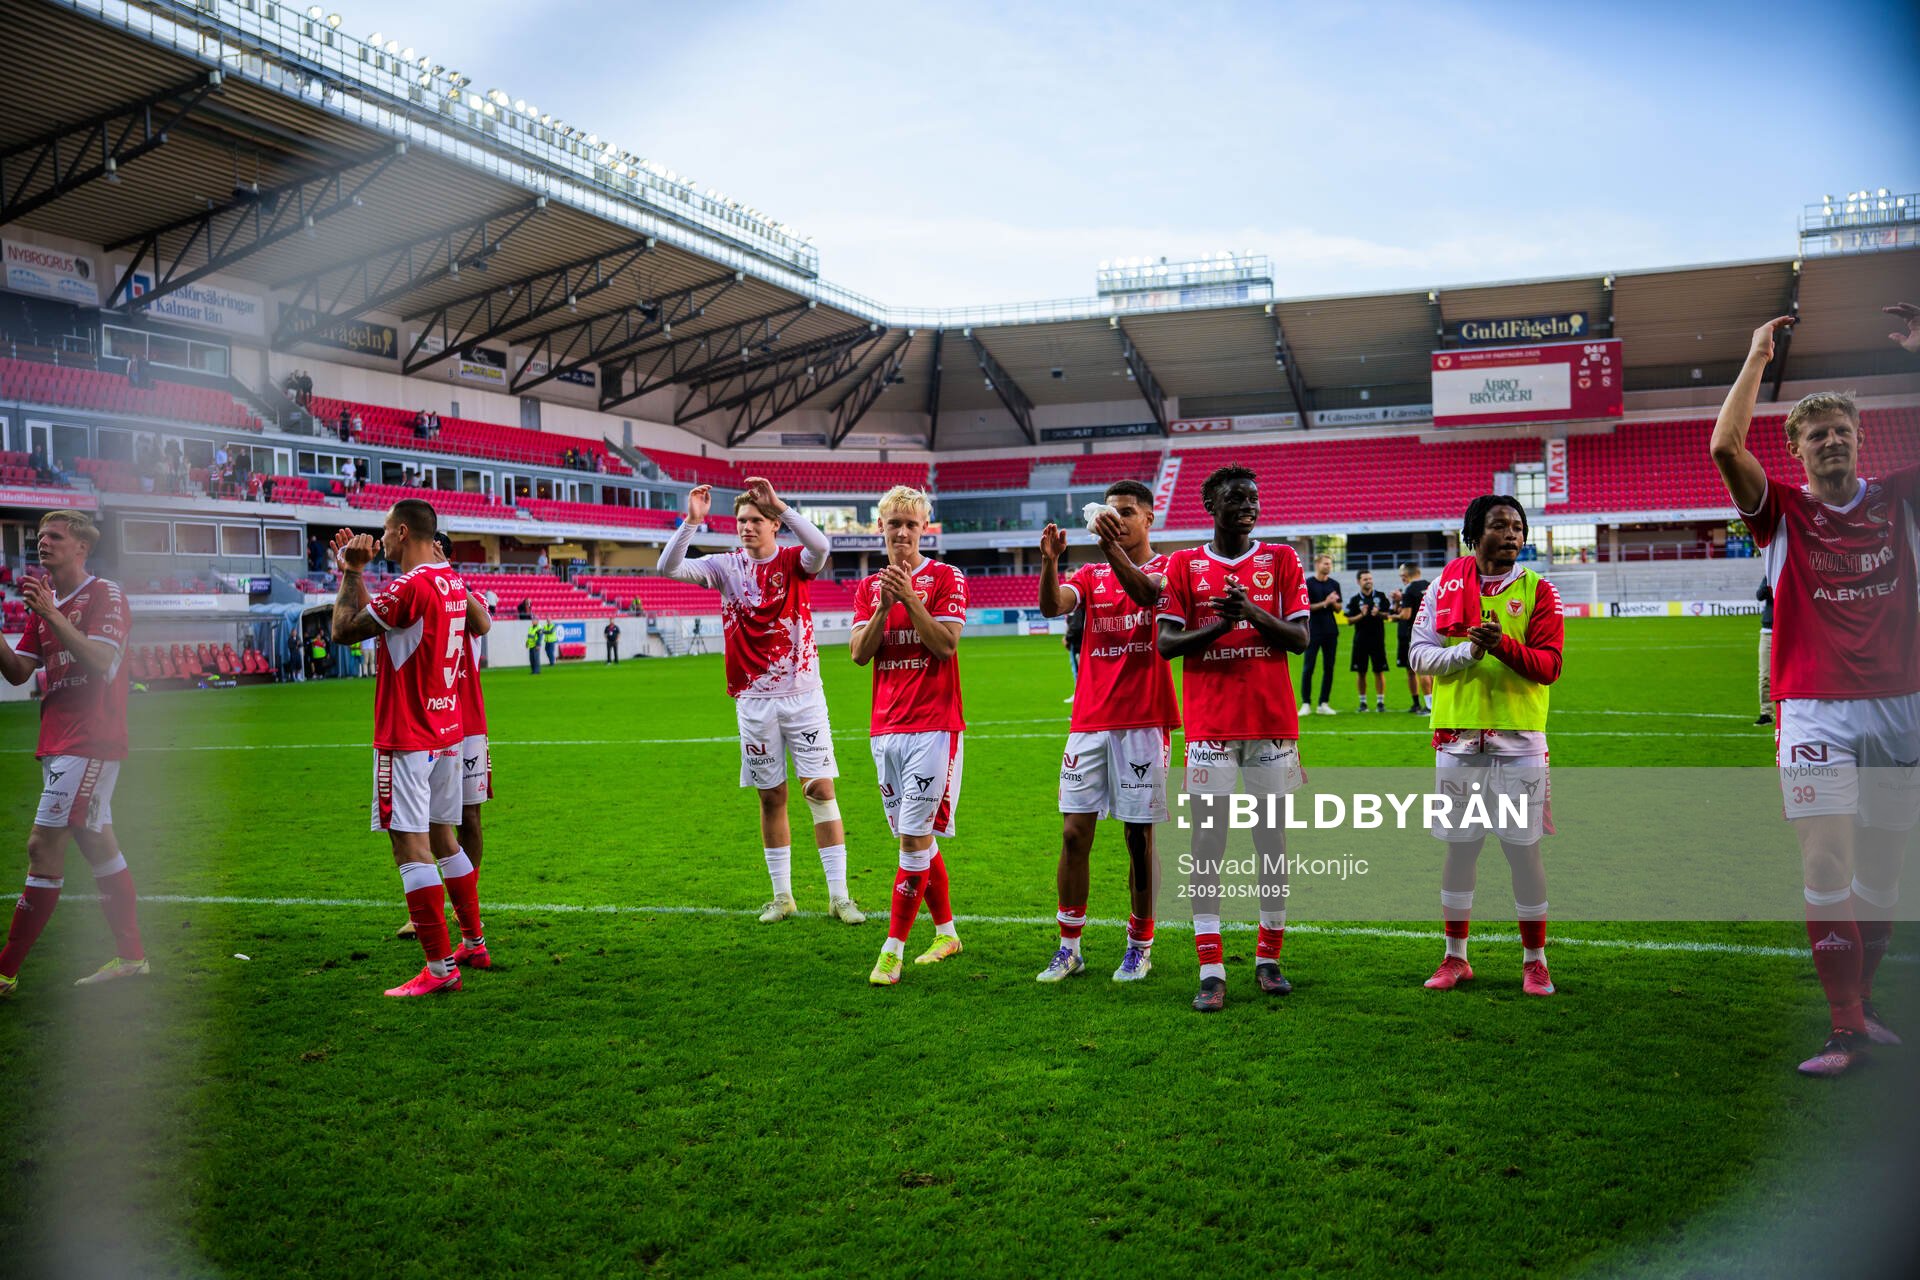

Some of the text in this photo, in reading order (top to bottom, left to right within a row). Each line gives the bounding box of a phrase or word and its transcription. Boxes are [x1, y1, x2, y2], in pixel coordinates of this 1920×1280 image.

[169, 285, 256, 315] nsförsäkringar
[156, 298, 224, 324] Kalmar län
[1461, 317, 1570, 341] GuldFågeln
[1483, 378, 1520, 394] ÅBRO
[1469, 389, 1533, 405] BRYGGERI
[1171, 420, 1229, 432] OVE
[1549, 443, 1564, 493] MAXI
[1154, 463, 1177, 511] MAXI
[1622, 602, 1660, 614] weber
[1709, 603, 1762, 616] Thermi
[443, 616, 466, 689] 5
[1090, 641, 1153, 657] ALEMTEK
[1202, 646, 1271, 662] ALEMTEK
[878, 658, 929, 671] ALEMTEK
[1189, 749, 1229, 762] Nybloms
[1192, 768, 1209, 784] 20
[1783, 763, 1839, 781] Nybloms
[1792, 785, 1816, 804] 39
